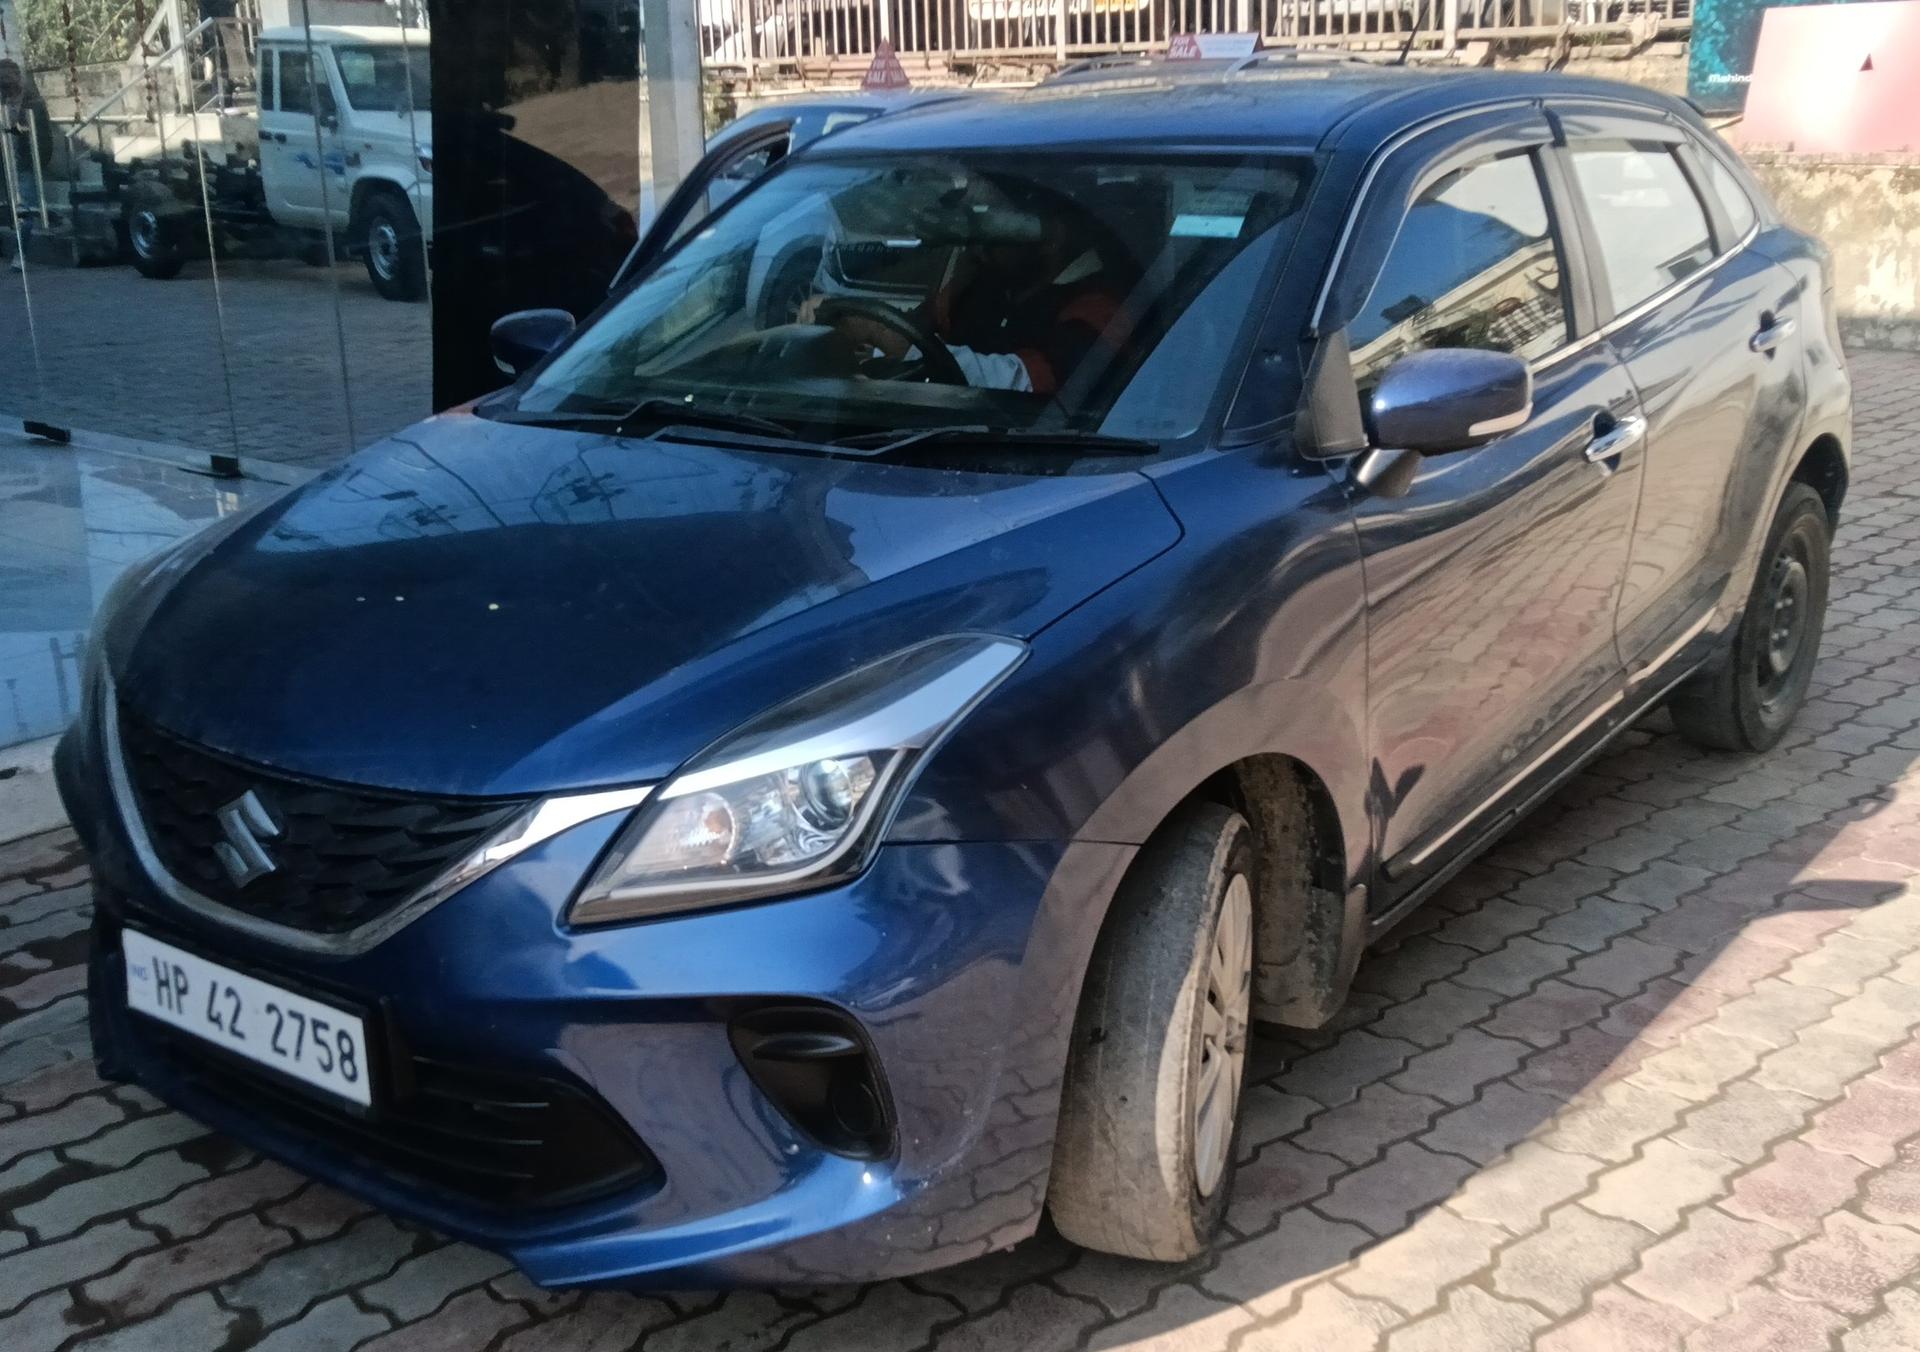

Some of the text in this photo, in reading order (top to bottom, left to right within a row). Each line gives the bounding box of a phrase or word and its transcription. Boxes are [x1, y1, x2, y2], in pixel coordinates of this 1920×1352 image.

[1169, 46, 1198, 58] SALE
[152, 956, 359, 1084] HP 42 2758
